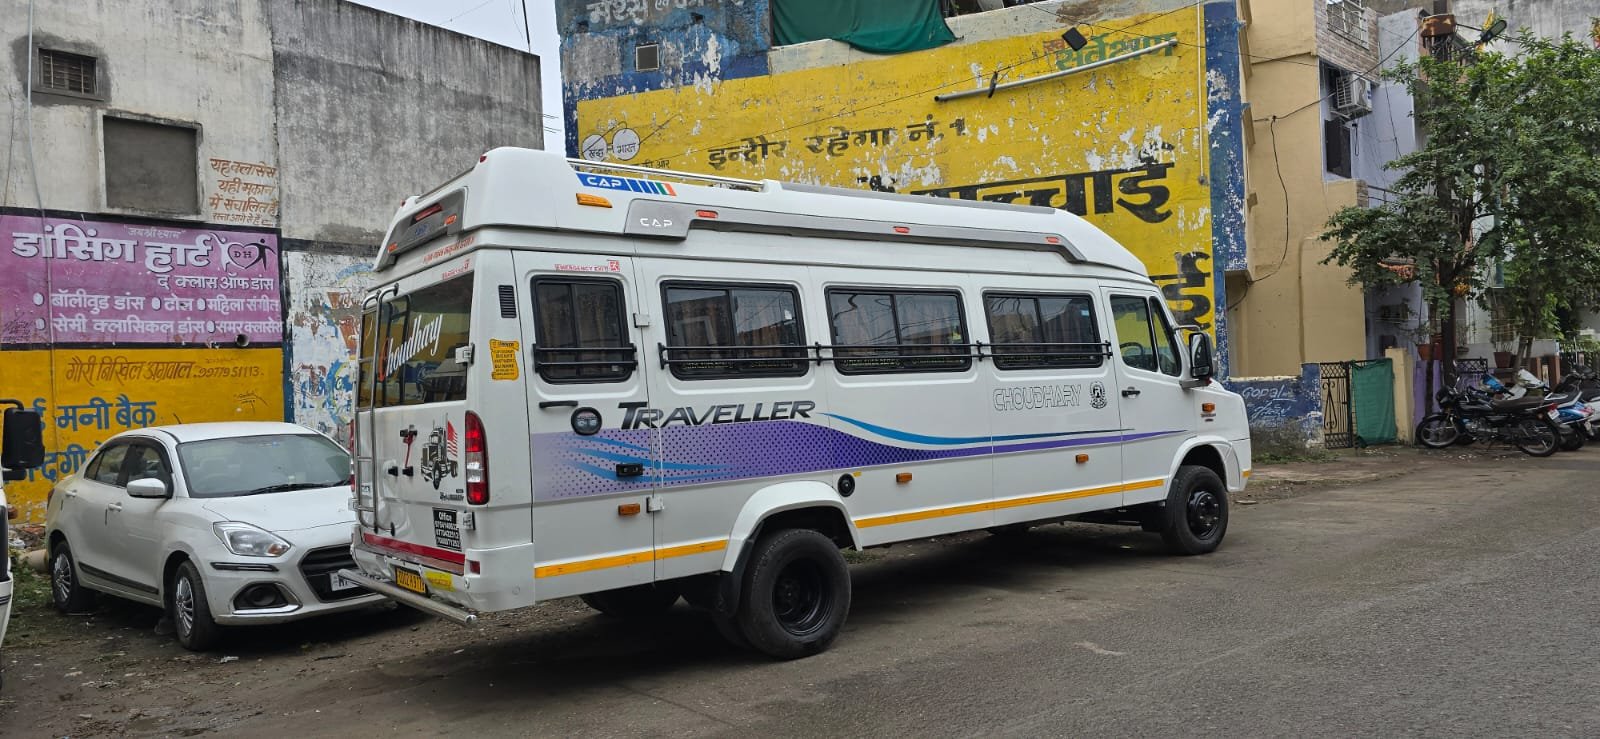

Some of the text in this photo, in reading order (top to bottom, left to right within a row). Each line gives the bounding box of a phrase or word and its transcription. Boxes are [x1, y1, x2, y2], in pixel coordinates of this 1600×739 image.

[586, 176, 622, 188] CAP
[640, 217, 673, 228] CAP
[12, 223, 214, 274] डांसिंग हार्ट
[156, 271, 274, 290] द क्लास ऑफ डांस
[51, 289, 110, 315] बॉलीवुड
[114, 291, 146, 311] डांस
[207, 293, 245, 315] महिला
[52, 313, 88, 332] सेमी
[92, 314, 175, 333] क्लासिकल
[178, 316, 206, 334] डांस
[66, 355, 98, 387] गौरी
[57, 397, 113, 431] मनी
[618, 401, 815, 430] TRAVELLER
